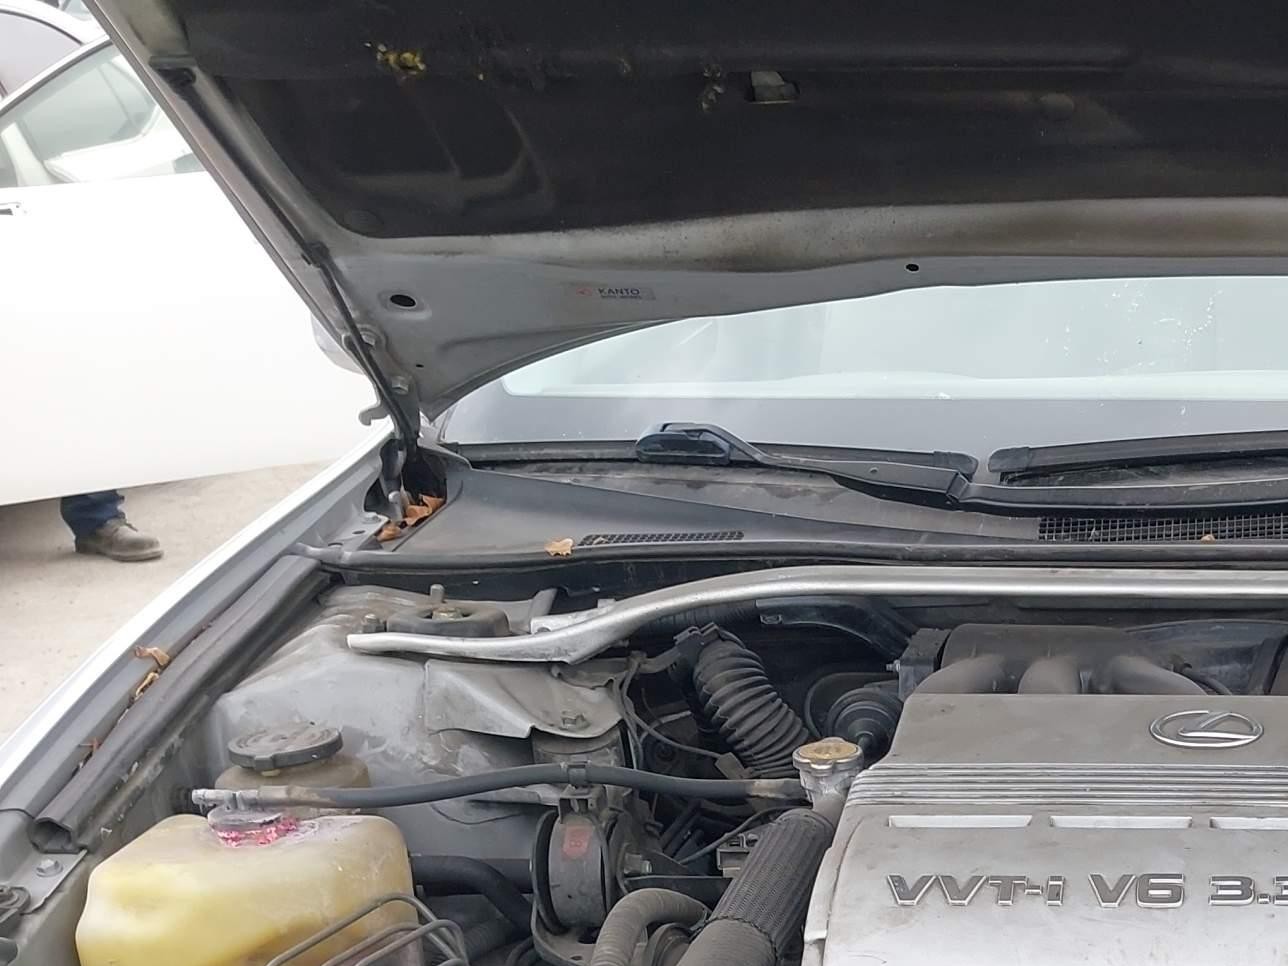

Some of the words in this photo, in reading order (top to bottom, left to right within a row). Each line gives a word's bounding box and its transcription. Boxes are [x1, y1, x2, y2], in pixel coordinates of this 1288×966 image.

[598, 287, 640, 295] KANTO
[886, 873, 1065, 907] VVT-i
[1088, 873, 1185, 909] V6
